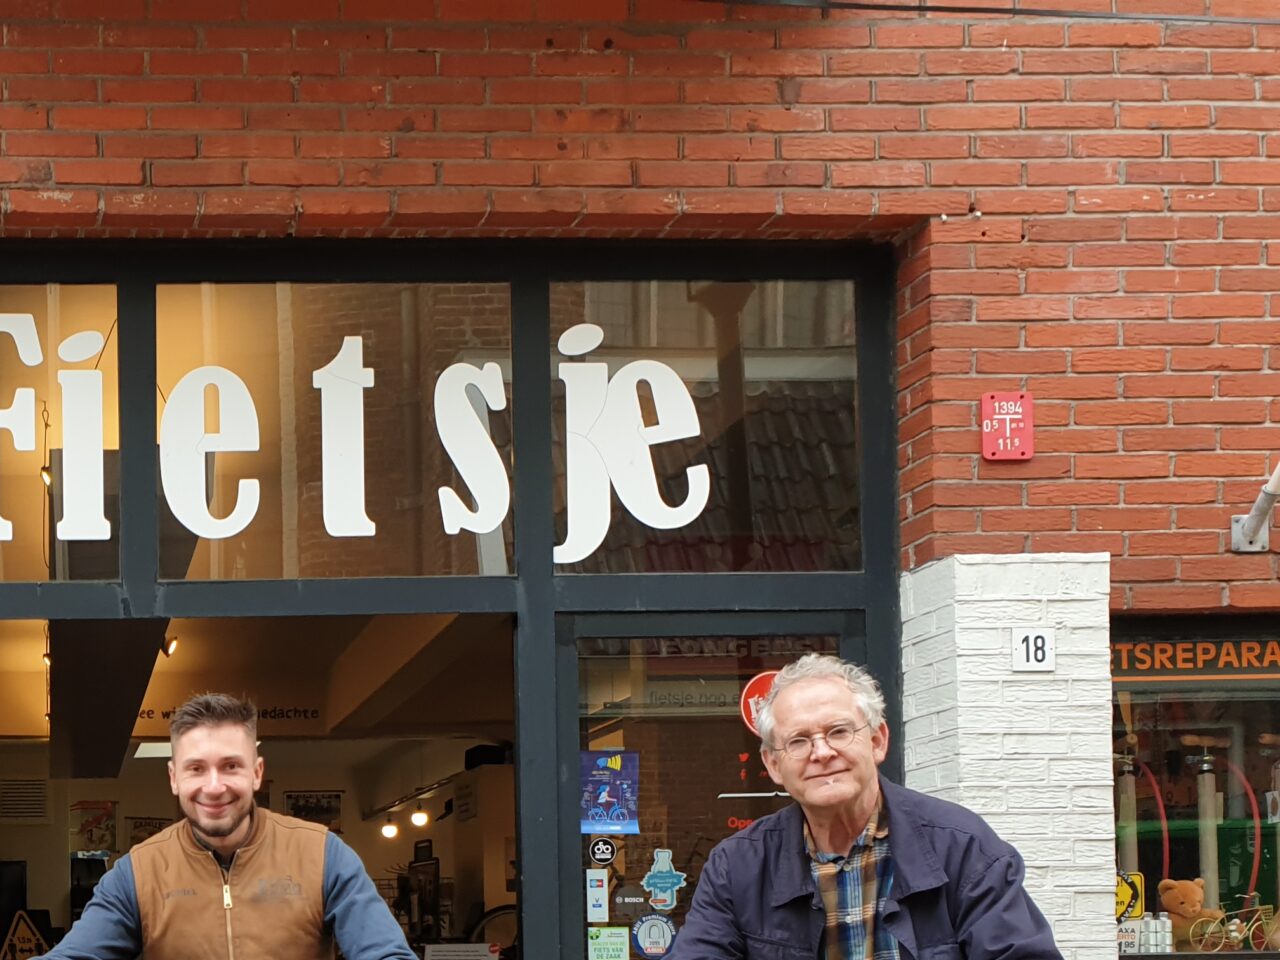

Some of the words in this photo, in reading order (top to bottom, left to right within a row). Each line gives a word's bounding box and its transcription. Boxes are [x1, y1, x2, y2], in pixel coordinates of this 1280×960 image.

[994, 402, 1022, 413] 1394
[1021, 635, 1046, 663] 18
[1111, 641, 1280, 669] TSREPARA
[257, 706, 319, 719] edachte
[728, 816, 753, 829] Ope
